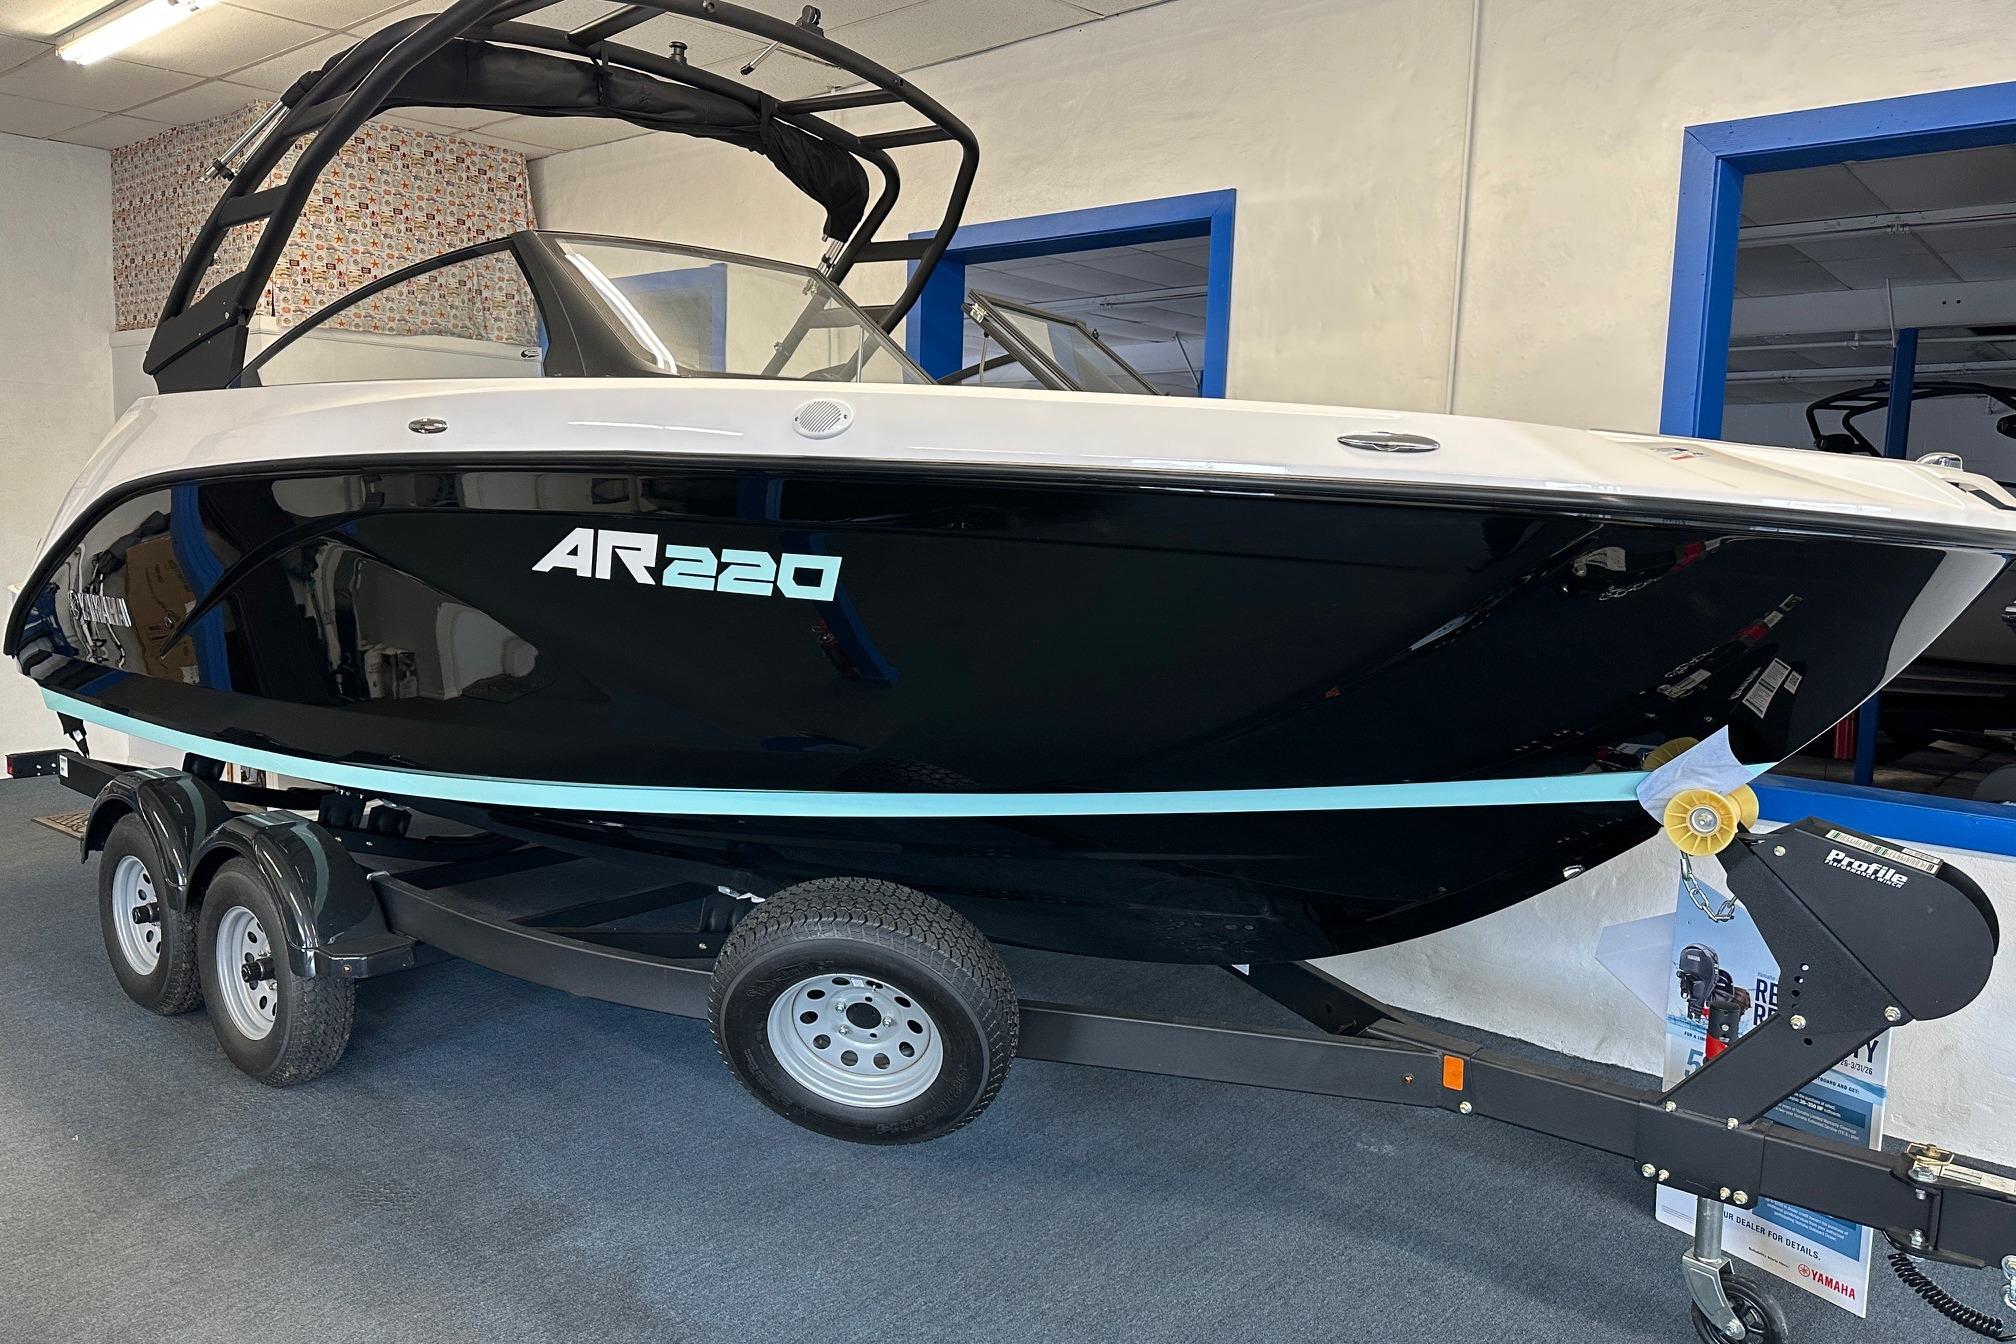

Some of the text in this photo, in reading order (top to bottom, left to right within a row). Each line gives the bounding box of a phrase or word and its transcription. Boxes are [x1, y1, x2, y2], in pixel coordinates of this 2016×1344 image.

[532, 527, 843, 602] AR220
[1824, 859, 1905, 889] PERFORMANCE WINCH
[1825, 849, 1909, 884] Profile
[1736, 1216, 1766, 1235] DEALER
[1768, 1230, 1784, 1243] FOR
[1785, 1238, 1821, 1261] DETAILS.
[1811, 1269, 1856, 1300] YAMAHA
